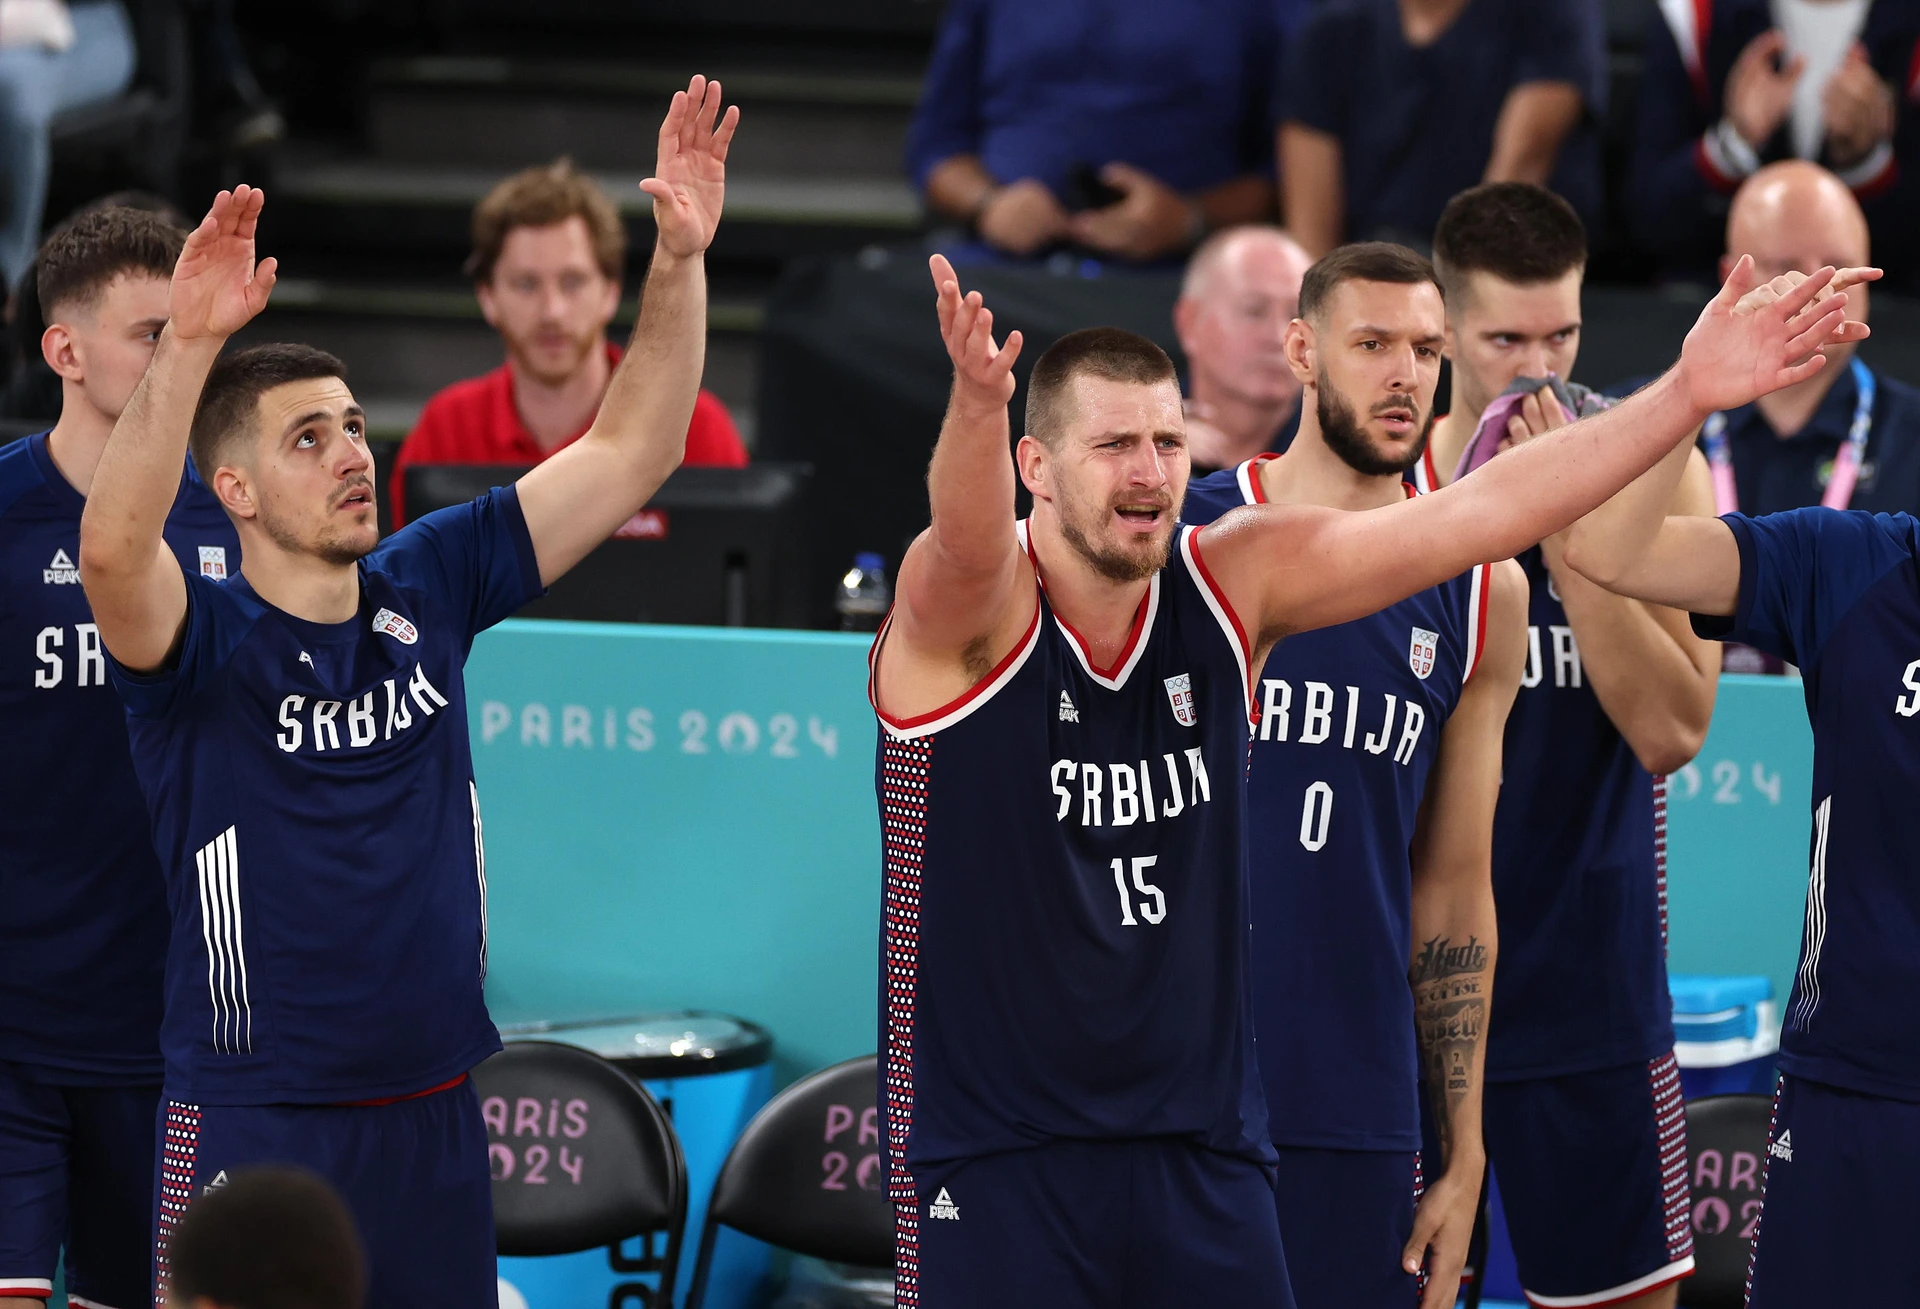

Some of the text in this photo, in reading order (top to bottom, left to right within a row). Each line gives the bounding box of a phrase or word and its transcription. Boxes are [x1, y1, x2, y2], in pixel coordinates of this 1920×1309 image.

[43, 569, 81, 584] PEAK
[35, 623, 105, 689] SR
[1520, 625, 1582, 688] JA
[276, 661, 449, 752] SRBIJA
[678, 708, 838, 758] 2024
[1259, 679, 1425, 766] RBIJA
[1050, 745, 1211, 827] SRBIJA
[1667, 760, 1781, 805] 024
[1299, 781, 1333, 852] 0
[1110, 855, 1167, 926] 15
[489, 1143, 584, 1184] 024
[1693, 1149, 1759, 1191] AR
[1770, 1142, 1794, 1162] PEAK
[929, 1205, 960, 1220] PEAK
